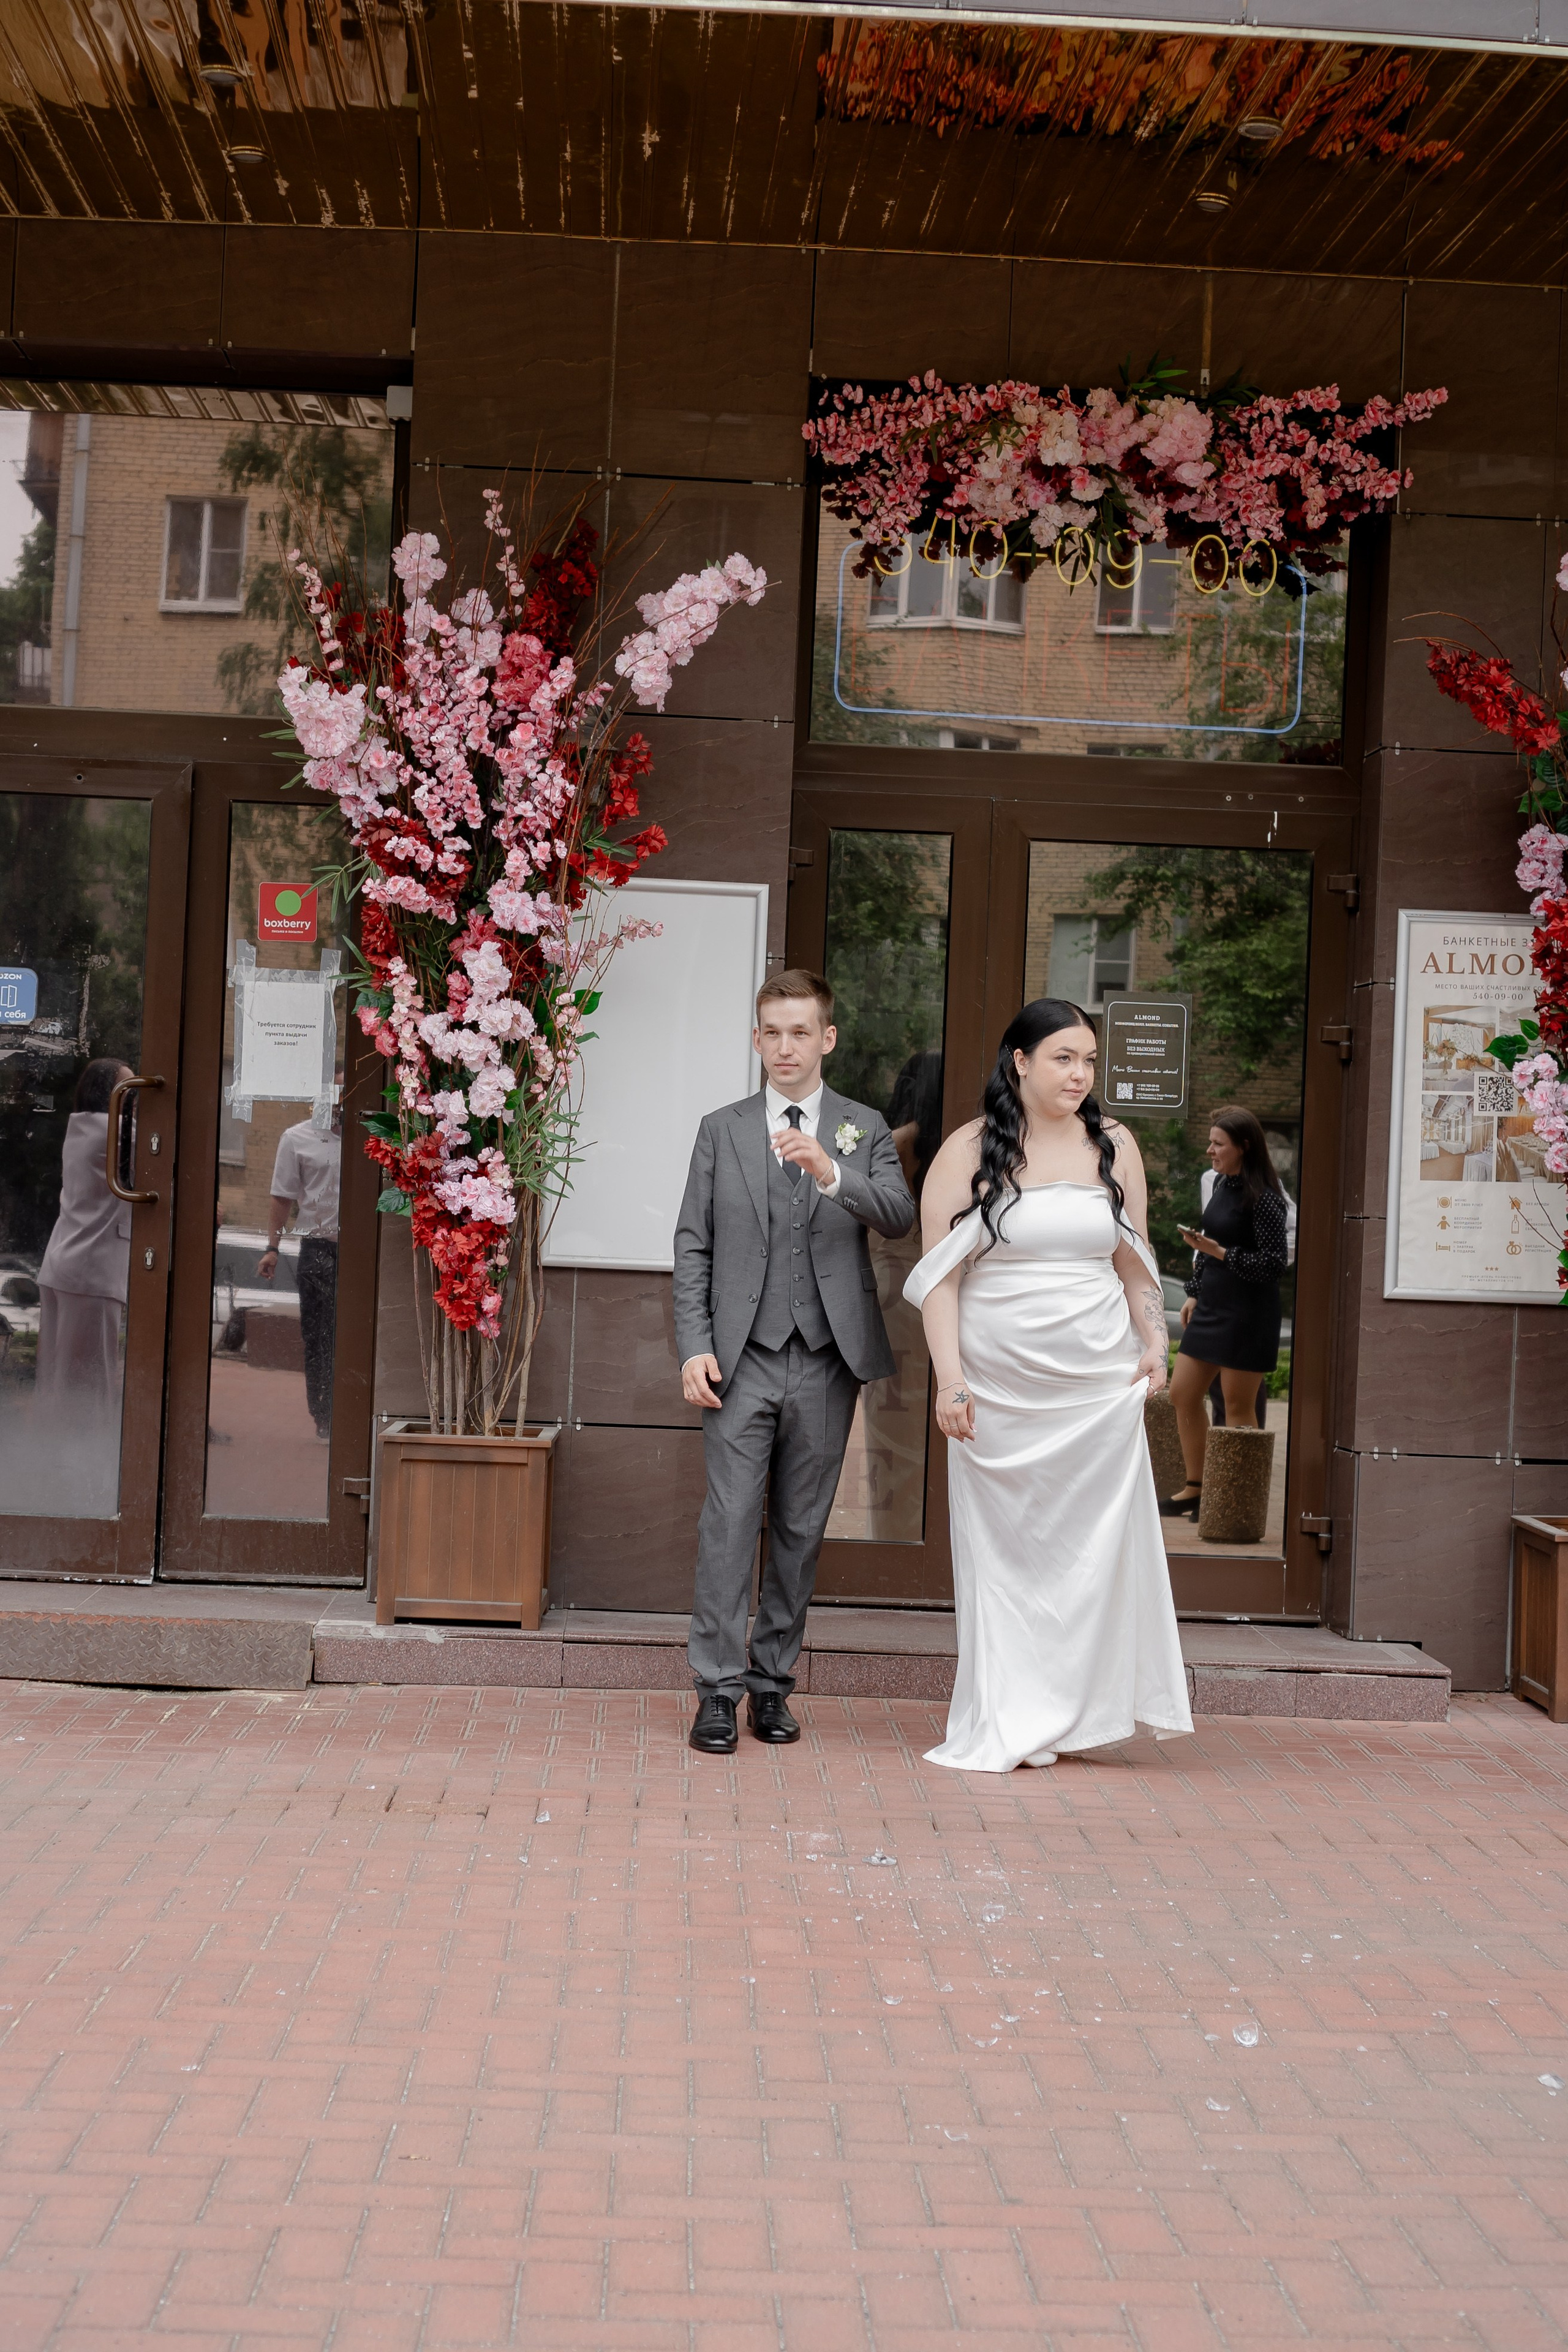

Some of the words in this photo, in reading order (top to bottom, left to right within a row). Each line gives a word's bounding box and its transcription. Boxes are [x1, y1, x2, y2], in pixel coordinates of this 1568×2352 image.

[264, 918, 311, 930] boxberry
[1443, 936, 1516, 947] БАНКЕТНЫЕ
[4, 1009, 26, 1019] себя
